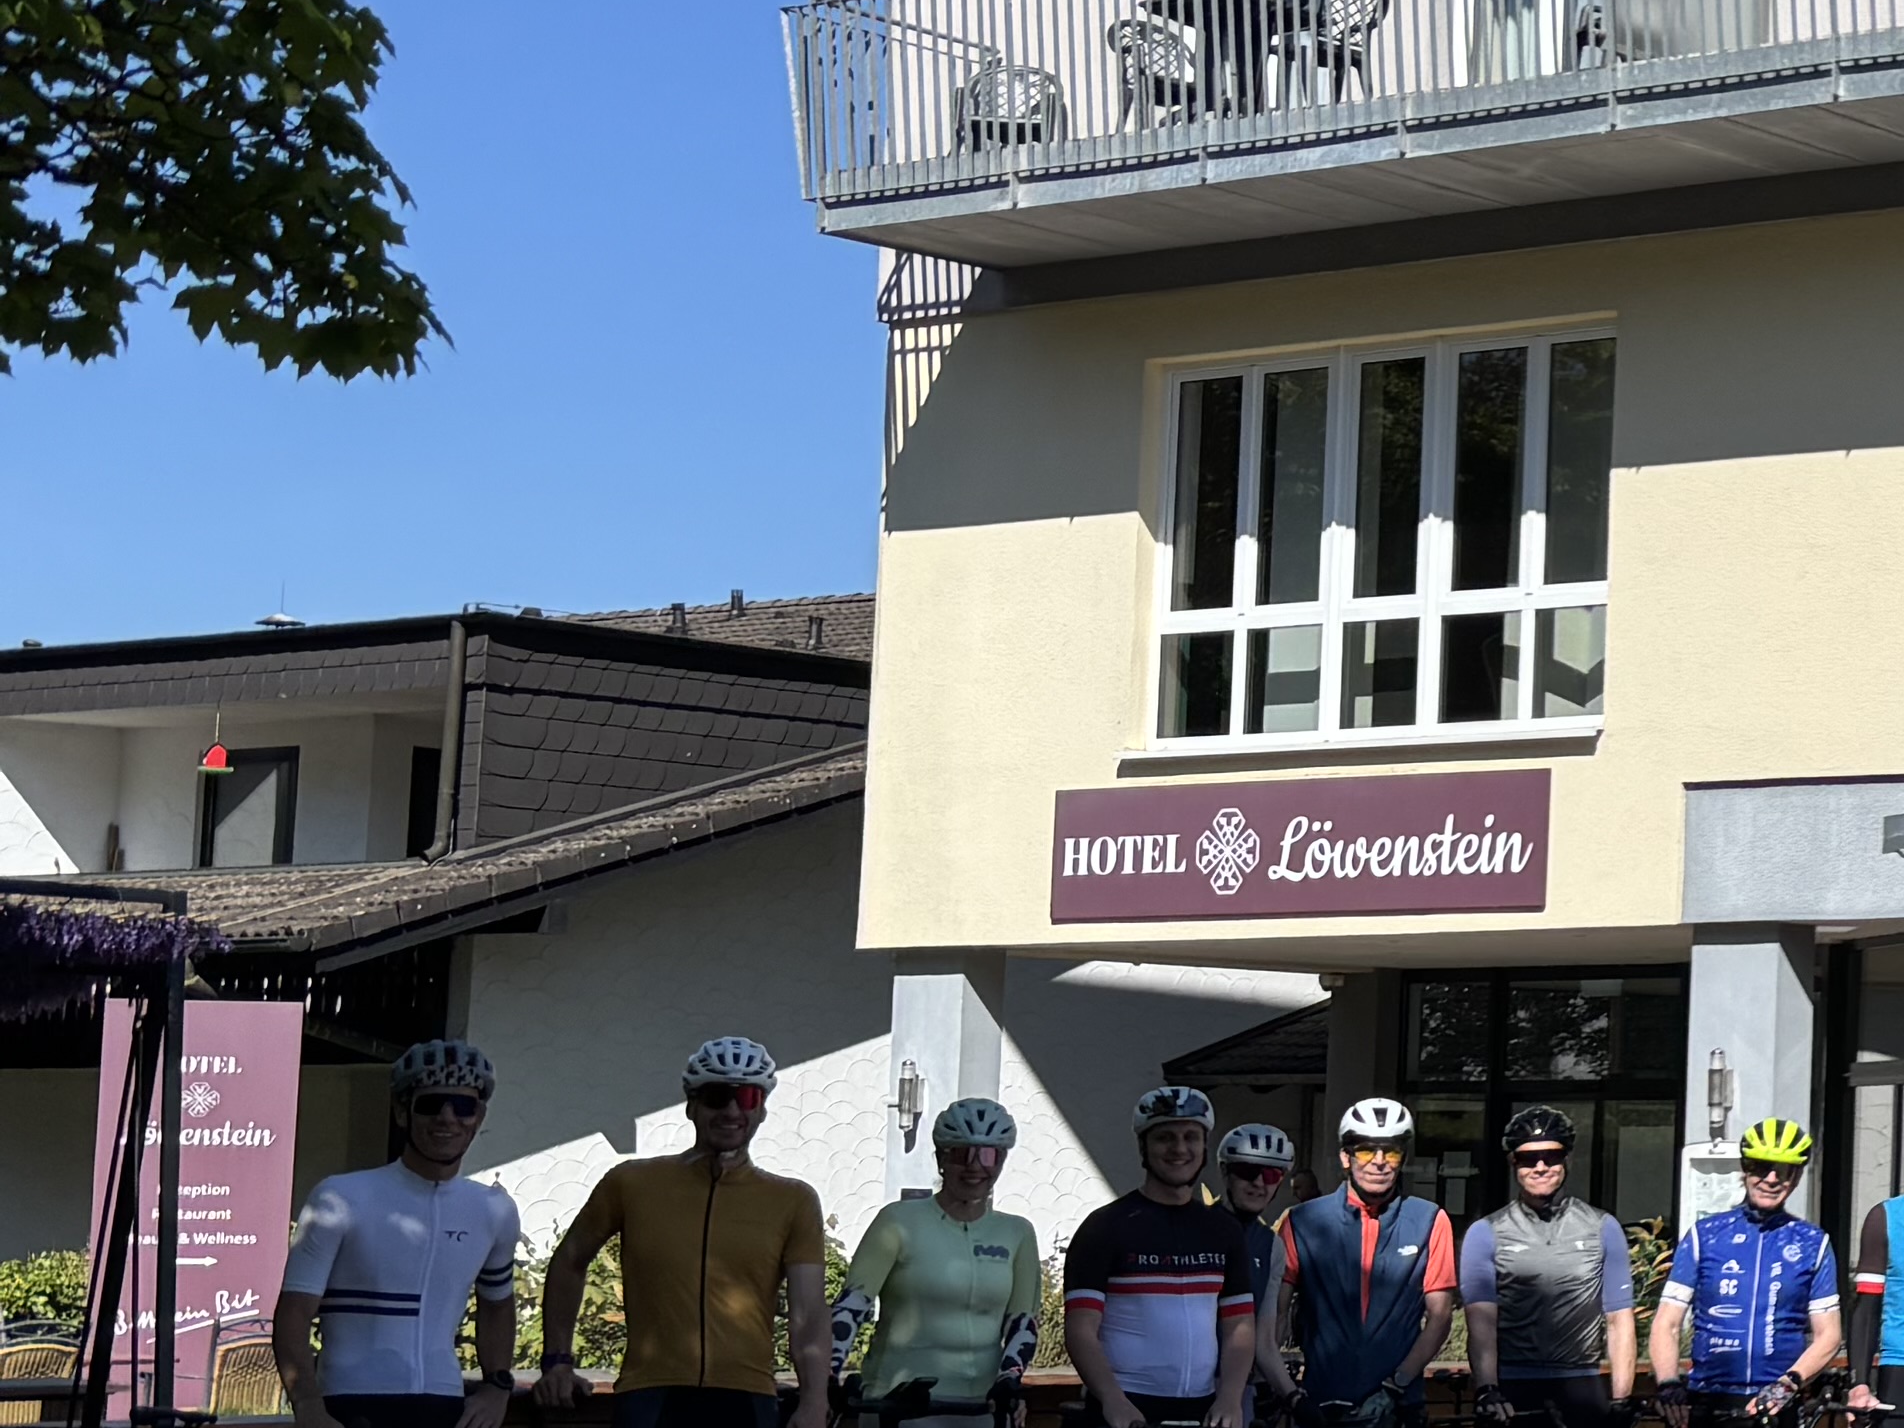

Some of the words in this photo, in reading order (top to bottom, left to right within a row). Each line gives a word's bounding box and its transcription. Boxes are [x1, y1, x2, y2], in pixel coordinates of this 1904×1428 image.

[1062, 834, 1187, 877] HOTEL
[1268, 813, 1534, 882] Löwenstein
[180, 1056, 243, 1074] OTEL
[120, 1120, 276, 1147] öenstein
[194, 1232, 257, 1245] Wellness
[1719, 1278, 1739, 1295] SC
[174, 1306, 210, 1322] ein
[215, 1289, 260, 1314] Bit
